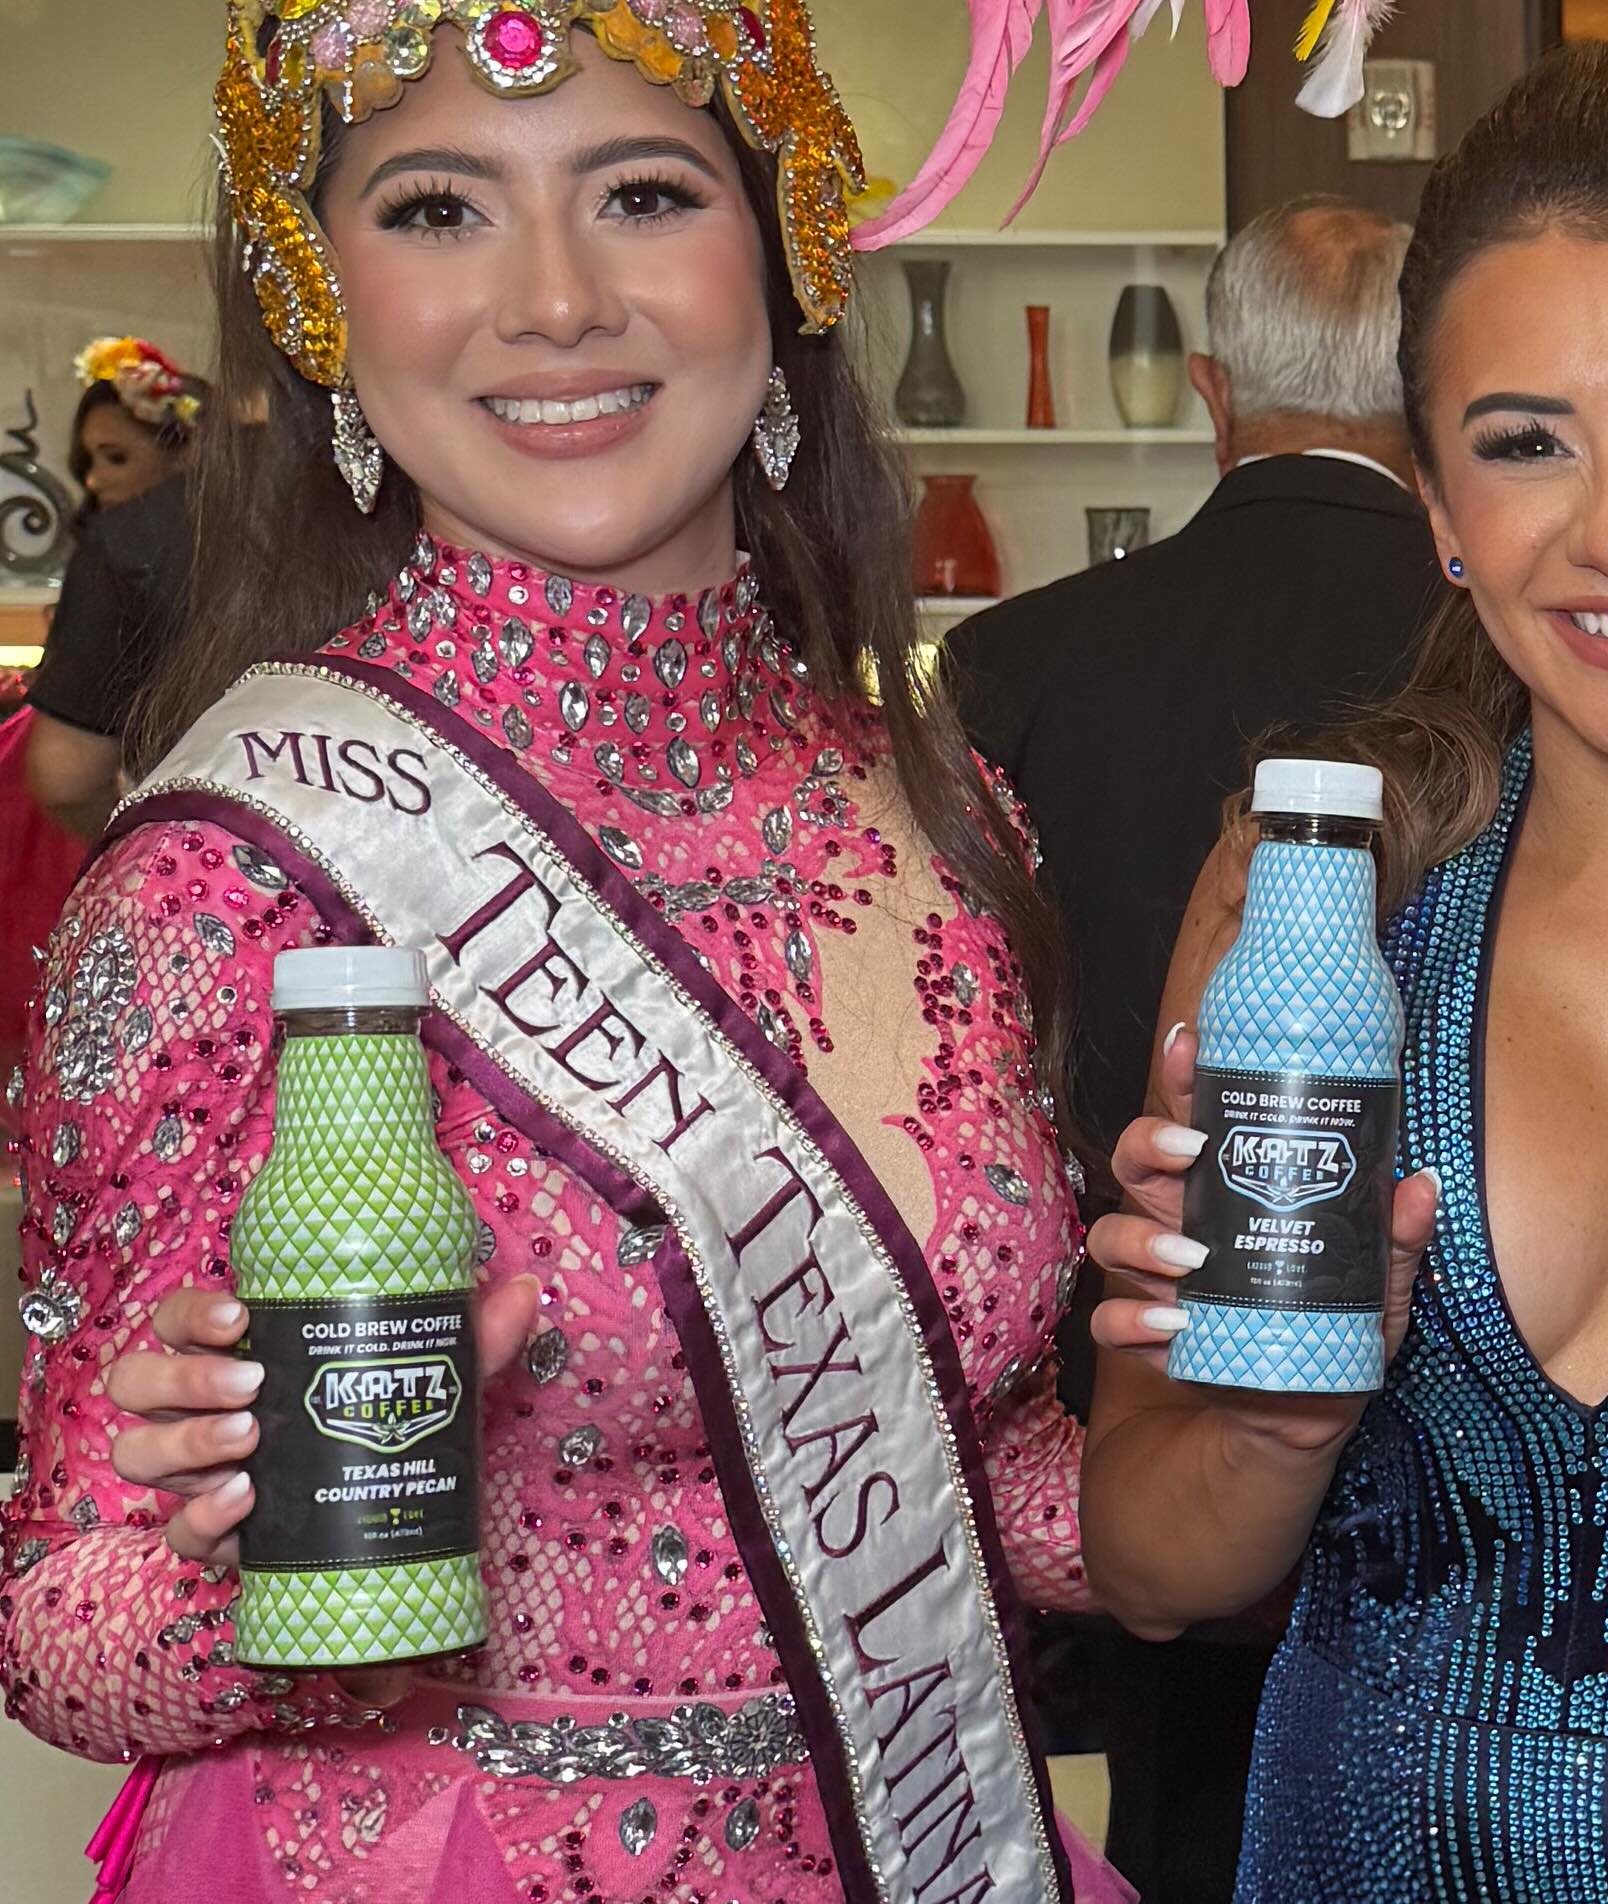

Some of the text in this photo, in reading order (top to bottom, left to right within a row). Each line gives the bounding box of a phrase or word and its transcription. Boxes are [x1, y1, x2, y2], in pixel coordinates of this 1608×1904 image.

[1221, 1090, 1362, 1114] COLD BREW COFFEE
[235, 730, 433, 817] MISS
[434, 840, 718, 1154] TEEN
[723, 1145, 900, 1559] TEXAS
[1231, 1134, 1341, 1174] KATZ
[1245, 1165, 1324, 1182] COFFEE
[1247, 1217, 1316, 1236] VELVET
[1234, 1234, 1325, 1255] ESPRESSO
[302, 1314, 462, 1340] COLD BREW COFFEE
[308, 1345, 341, 1356] DRINK
[344, 1344, 354, 1355] IT
[356, 1342, 391, 1354] COLD.
[325, 1364, 448, 1411] KATZ
[343, 1398, 434, 1419] COFFEE
[342, 1459, 437, 1482] TEXAS HILL
[314, 1475, 458, 1504] COUNTRY PECAN
